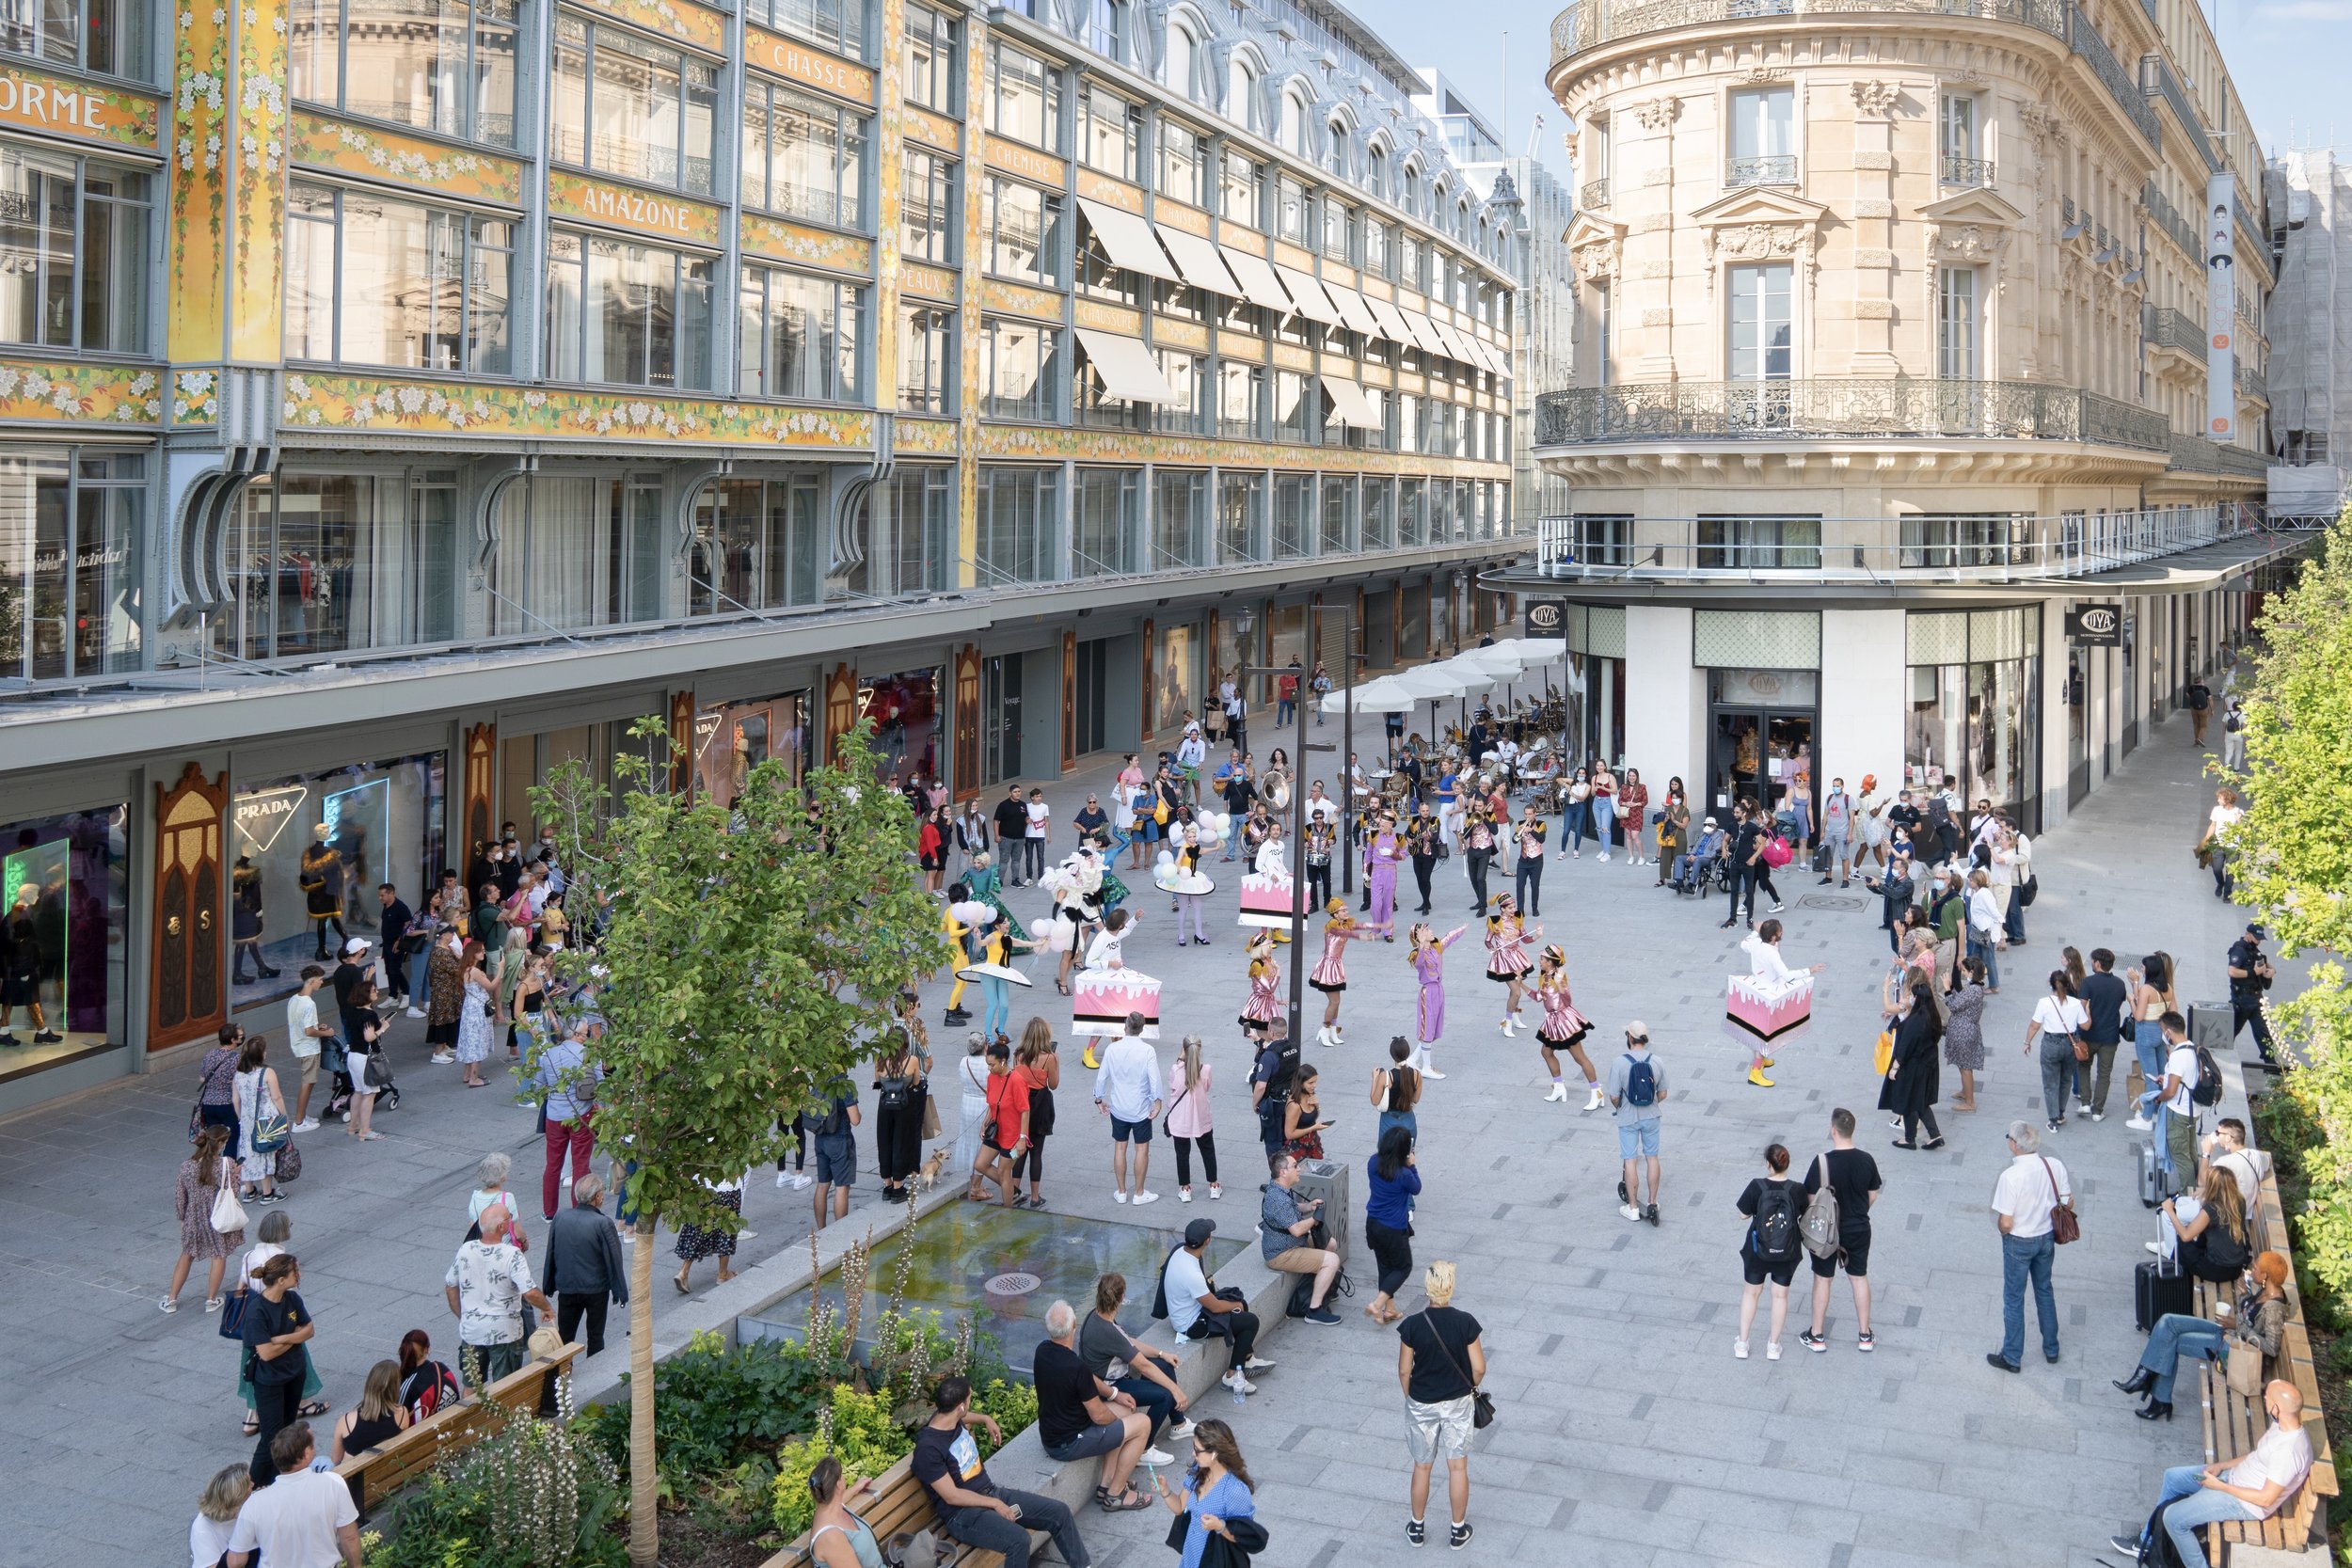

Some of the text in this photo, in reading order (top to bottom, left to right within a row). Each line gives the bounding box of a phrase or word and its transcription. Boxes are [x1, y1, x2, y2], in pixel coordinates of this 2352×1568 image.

[773, 45, 847, 89] CHASSE
[0, 77, 106, 130] ORME
[995, 146, 1049, 178] CHEMISE
[583, 187, 690, 231] AMAZONE
[1083, 306, 1133, 330] CHAUSSURE
[237, 799, 292, 820] PRADA
